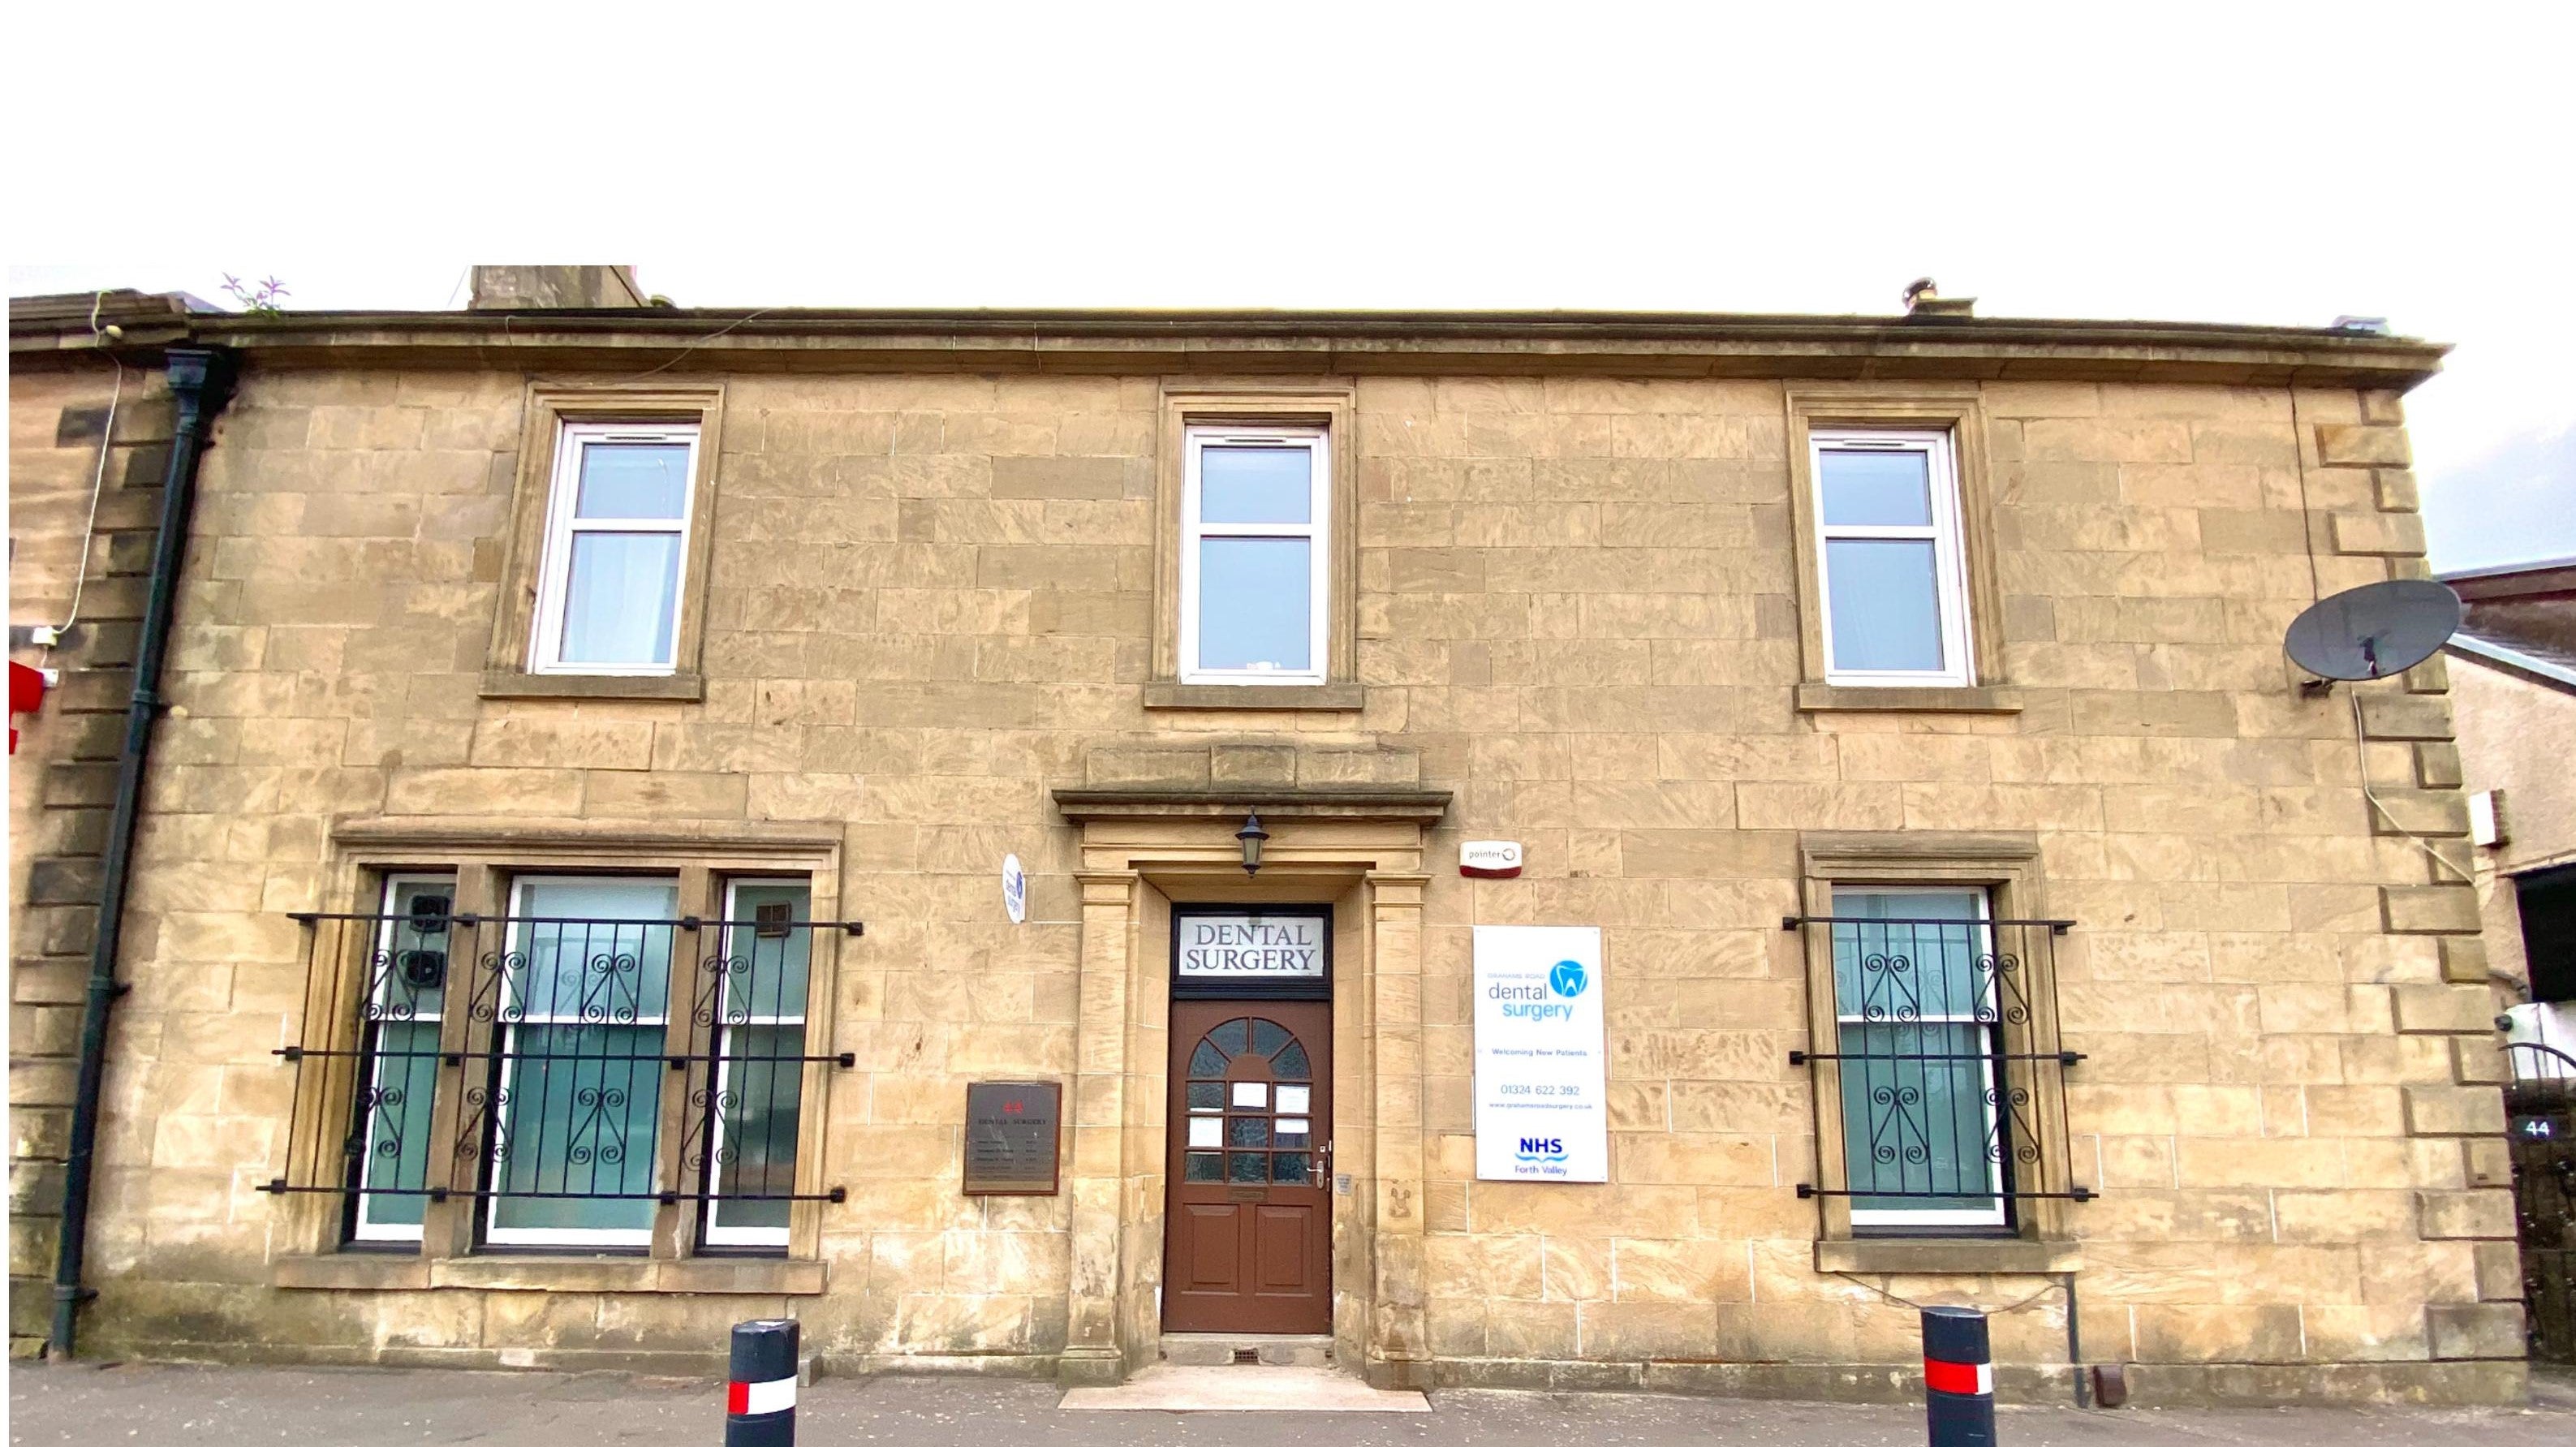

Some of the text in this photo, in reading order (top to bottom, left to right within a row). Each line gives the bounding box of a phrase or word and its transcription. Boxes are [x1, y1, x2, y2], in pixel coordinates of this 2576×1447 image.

[1469, 851, 1500, 859] pointer
[1195, 924, 1312, 945] DENTAL
[1187, 950, 1316, 970] SURGERY
[1488, 982, 1547, 1000] dental
[1502, 1003, 1573, 1022] surgery
[1492, 1048, 1533, 1057] Welcoming
[1500, 1084, 1580, 1096] 01324 622 392
[2526, 1121, 2550, 1135] 44
[1520, 1138, 1562, 1153] NHS
[1514, 1165, 1568, 1177] Forth Valley
